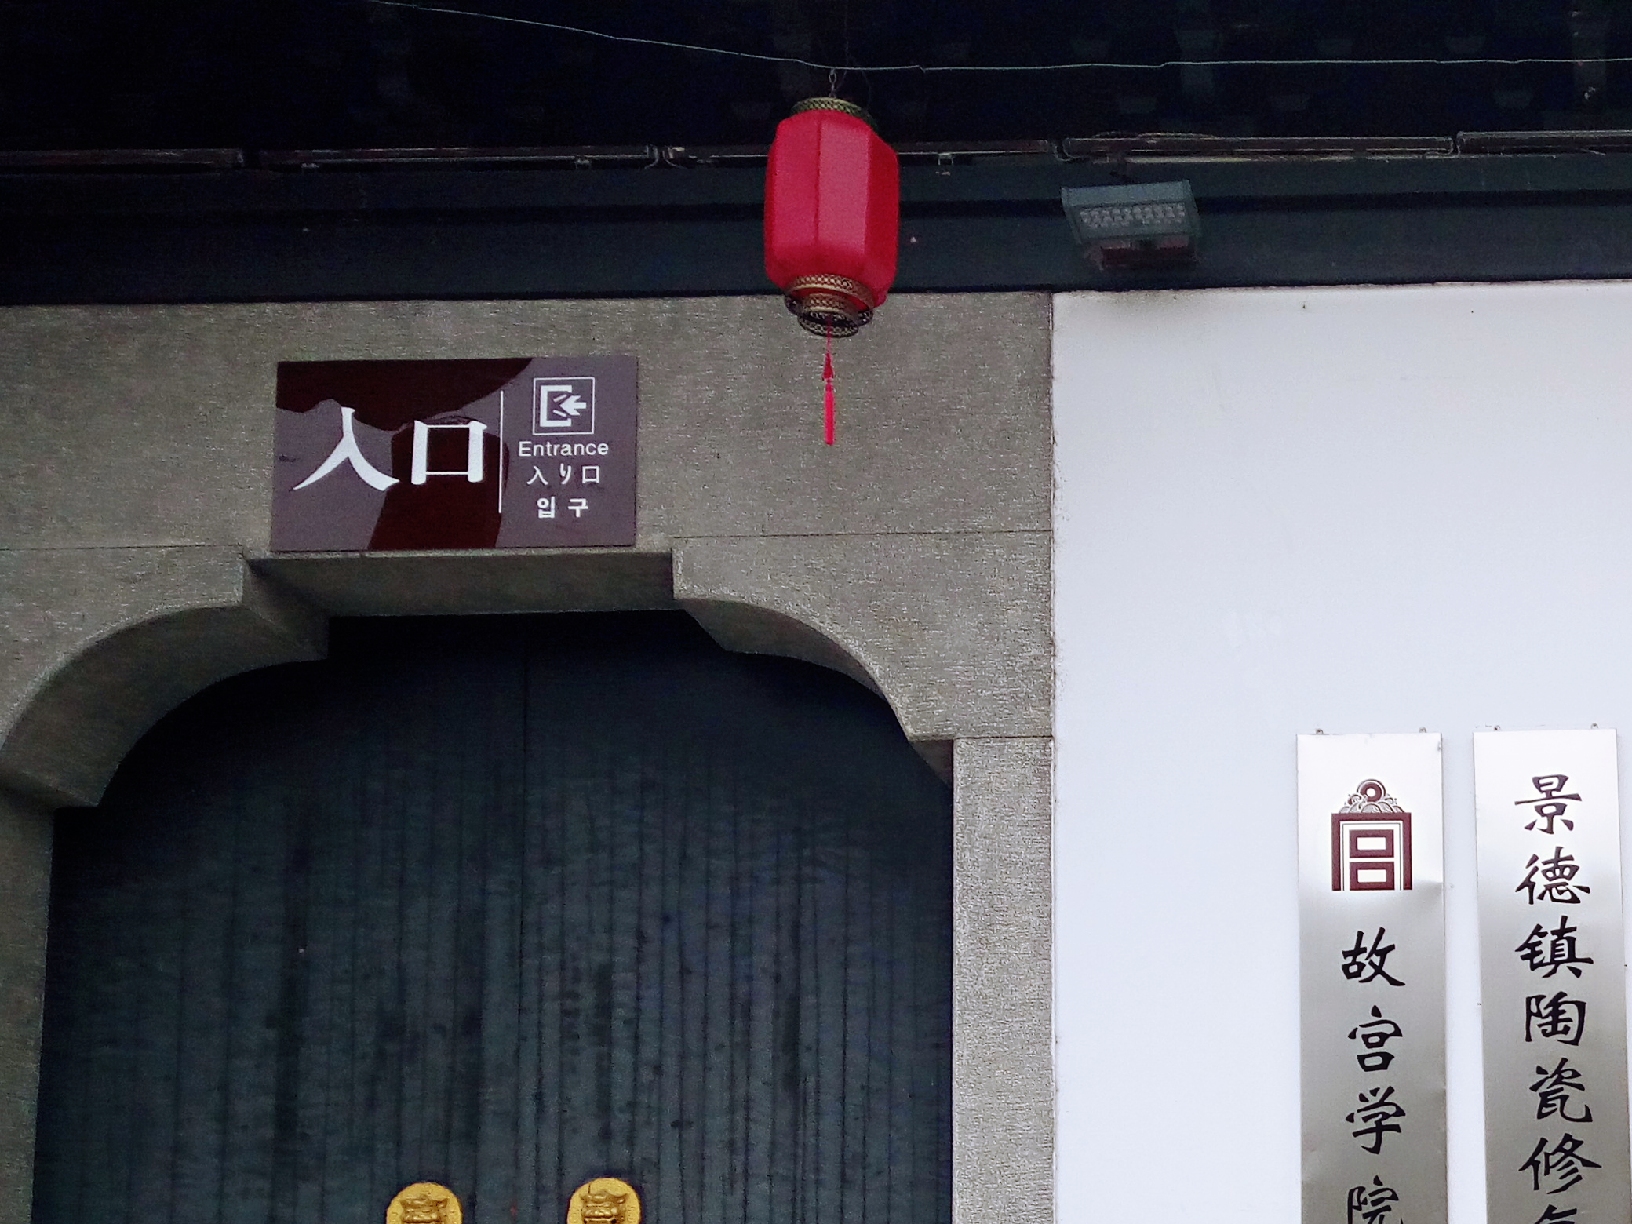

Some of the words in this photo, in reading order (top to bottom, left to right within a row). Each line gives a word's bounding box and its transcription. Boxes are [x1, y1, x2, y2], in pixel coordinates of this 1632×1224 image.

[293, 407, 487, 491] 入口
[518, 440, 609, 458] Entrance
[527, 463, 600, 485] 入り口
